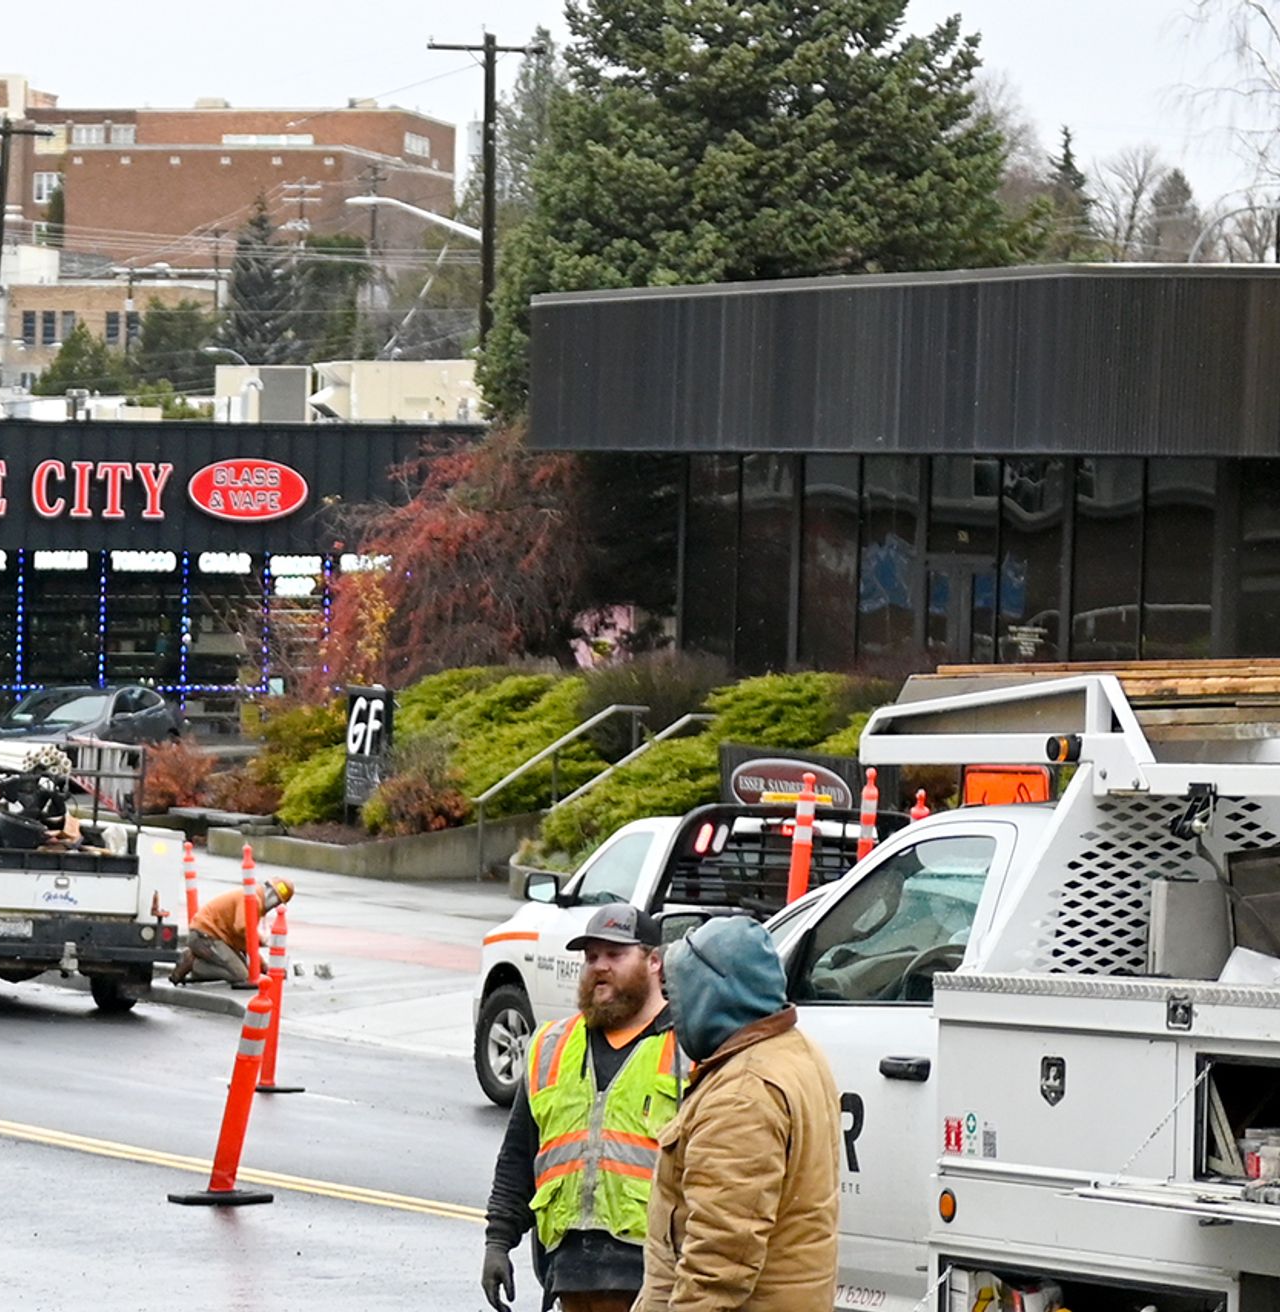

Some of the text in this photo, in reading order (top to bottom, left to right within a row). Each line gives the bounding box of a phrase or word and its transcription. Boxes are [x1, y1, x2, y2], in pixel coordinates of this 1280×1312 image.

[32, 459, 173, 518] CITY
[214, 467, 280, 487] GLASS
[209, 490, 281, 510] & VAPE
[348, 696, 384, 756] GF
